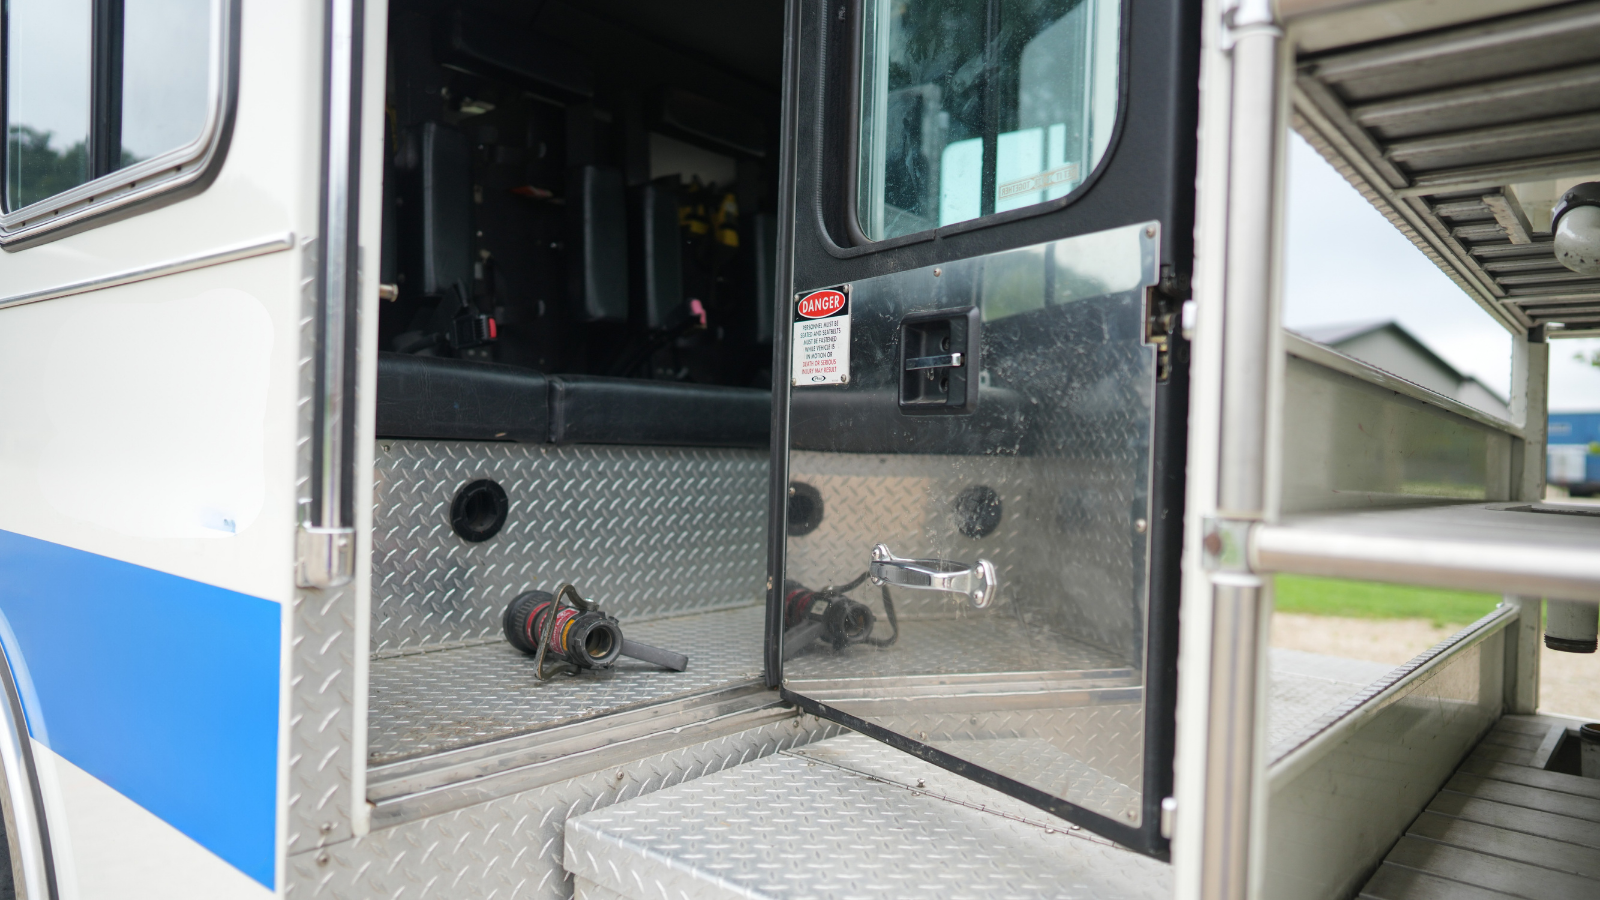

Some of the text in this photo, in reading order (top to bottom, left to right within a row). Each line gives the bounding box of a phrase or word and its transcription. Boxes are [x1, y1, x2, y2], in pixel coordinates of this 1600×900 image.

[802, 295, 840, 314] DANGER
[802, 322, 822, 331] PERSONNEL
[822, 328, 841, 336] SEATBELTS
